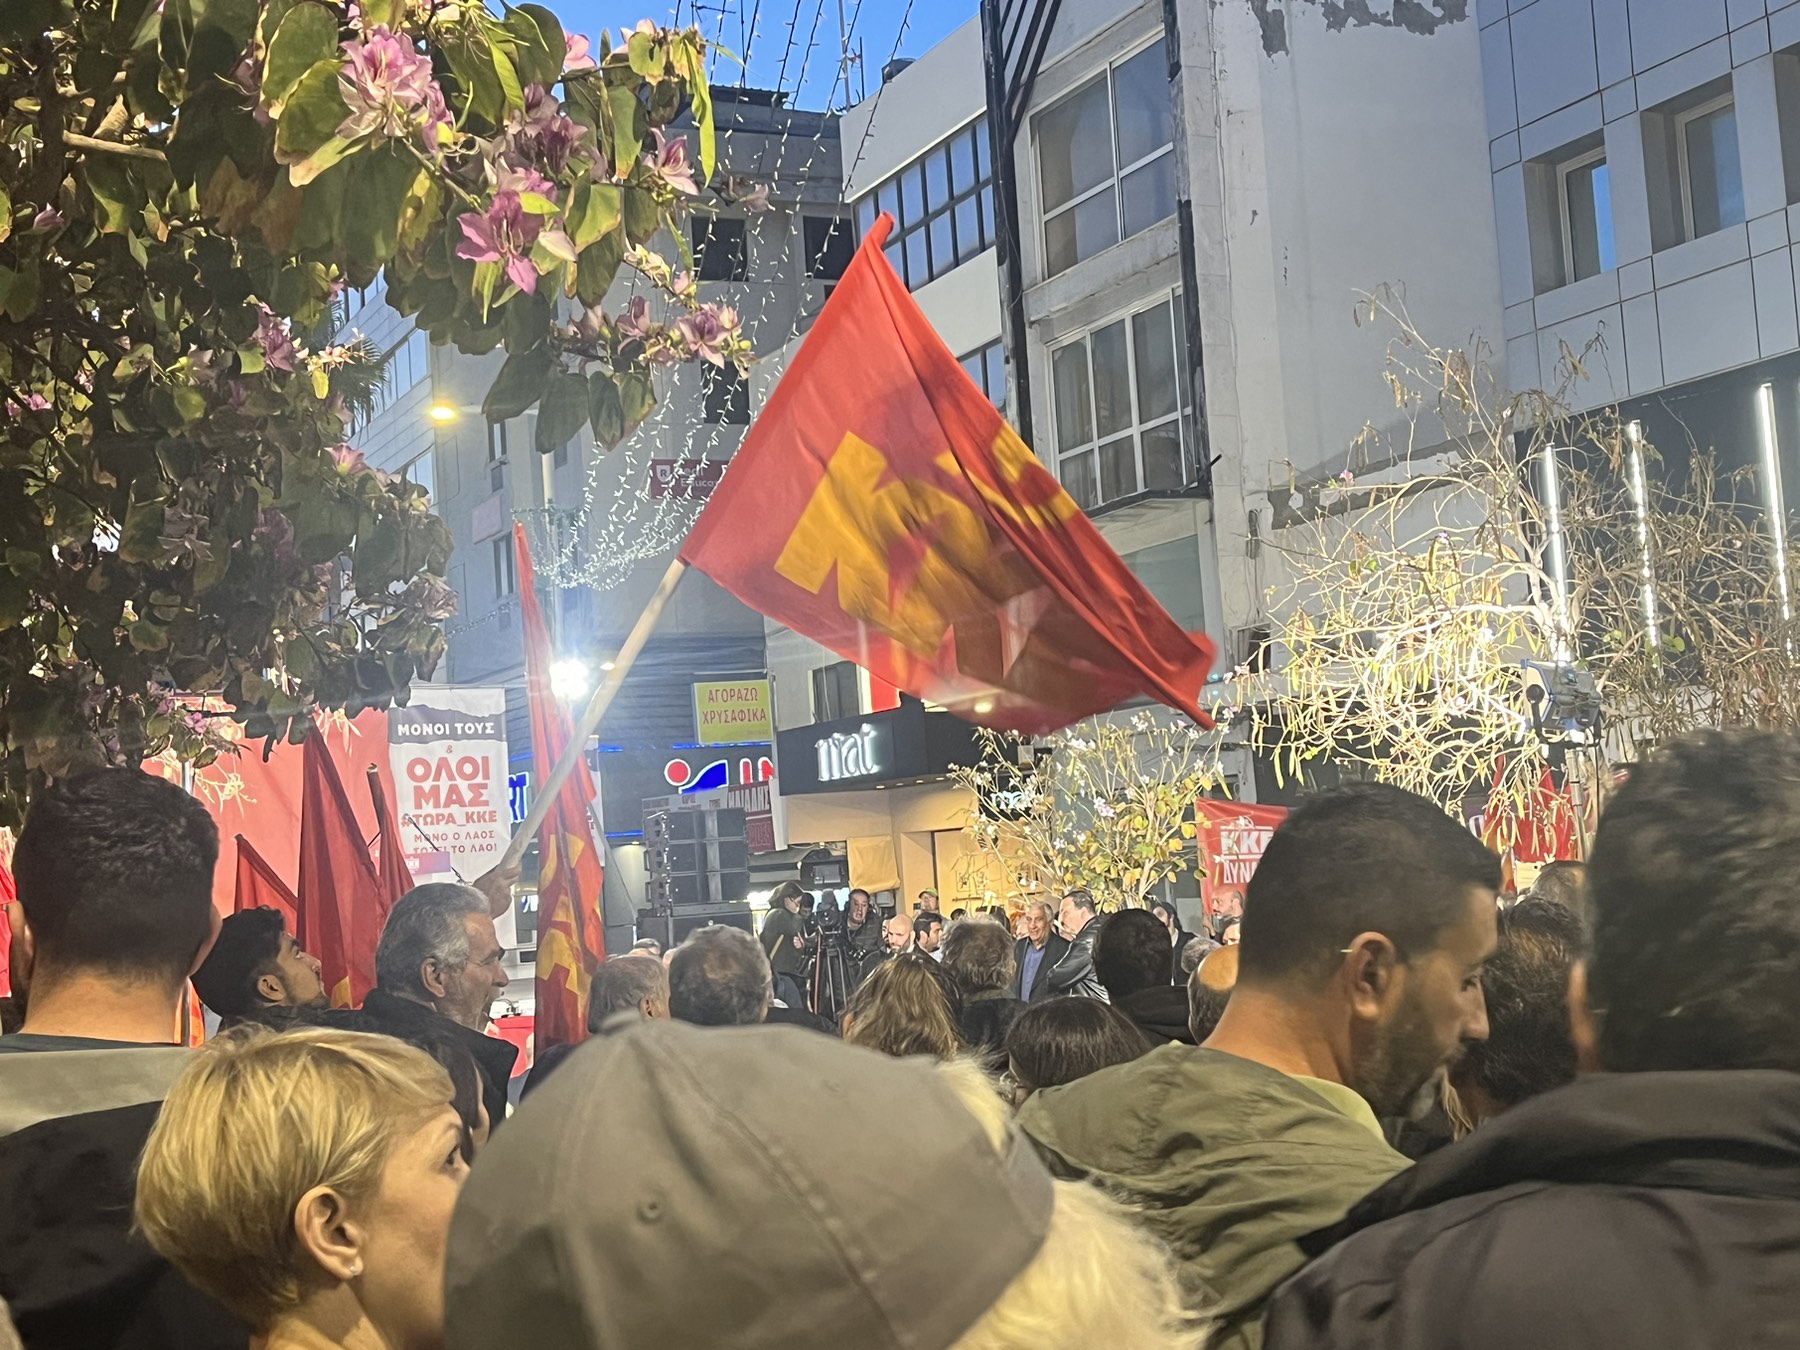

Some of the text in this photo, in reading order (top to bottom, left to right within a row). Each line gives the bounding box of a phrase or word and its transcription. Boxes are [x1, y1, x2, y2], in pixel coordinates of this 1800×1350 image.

[708, 687, 758, 703] ΑΓΟΡΑΖΩ
[702, 707, 767, 725] ΧΡΥΣΑΦΙΚΑ
[397, 722, 495, 736] ΜΟΝΟΙ ΤΟΥΣ
[406, 755, 490, 783] ΟΛΟΙ
[413, 783, 490, 809] ΜΑΣ
[414, 833, 448, 843] ΜΟΝΟ
[464, 830, 495, 841] ΛΑΟΣ
[450, 845, 466, 854] ΤΟ
[470, 843, 498, 853] ΛΑΟ!
